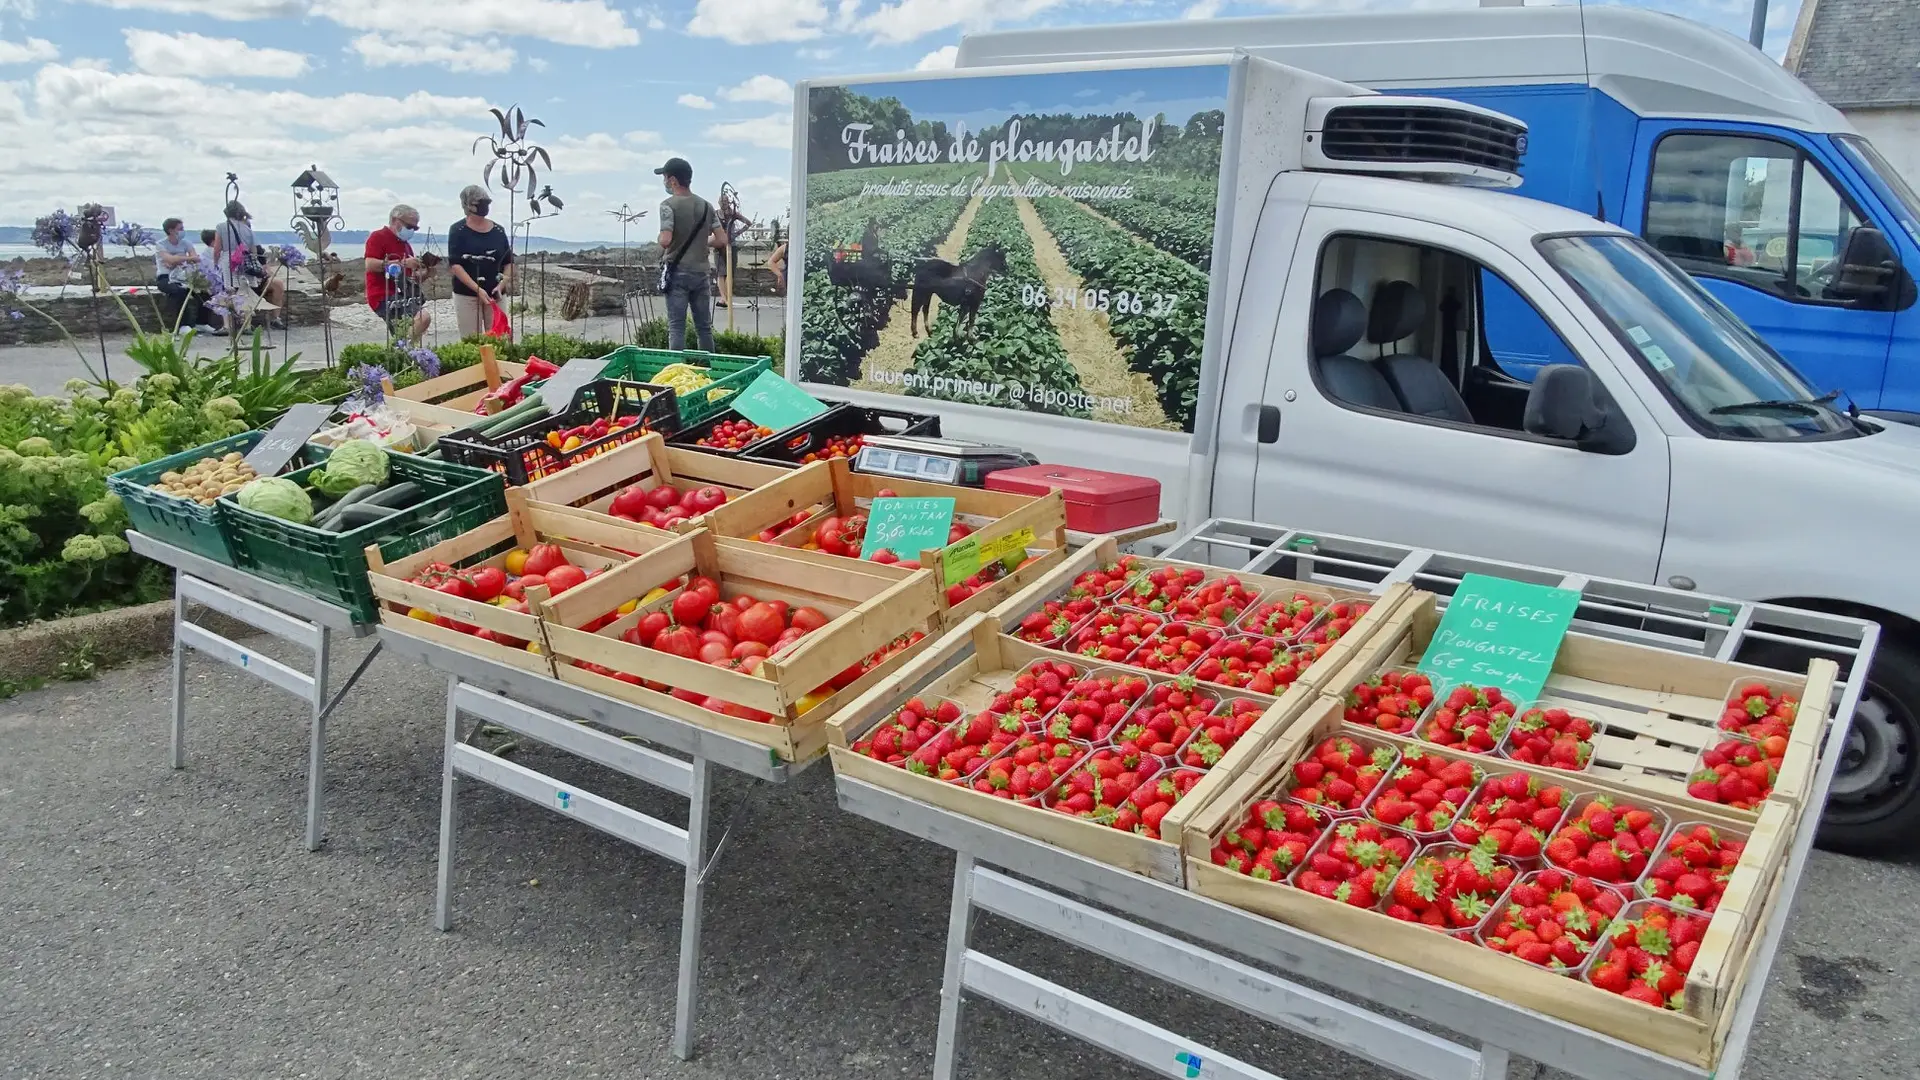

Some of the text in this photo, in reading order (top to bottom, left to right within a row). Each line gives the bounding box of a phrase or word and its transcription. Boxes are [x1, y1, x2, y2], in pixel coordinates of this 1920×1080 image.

[841, 115, 1156, 177] Fraises de plougastel
[861, 175, 1134, 204] produits issus de l'agriculture raisonnée
[1021, 283, 1178, 317] 06 34 05 86 37
[869, 362, 1001, 398] laurent.primeur
[873, 522, 906, 543] 3,60
[1470, 617, 1499, 632] DE
